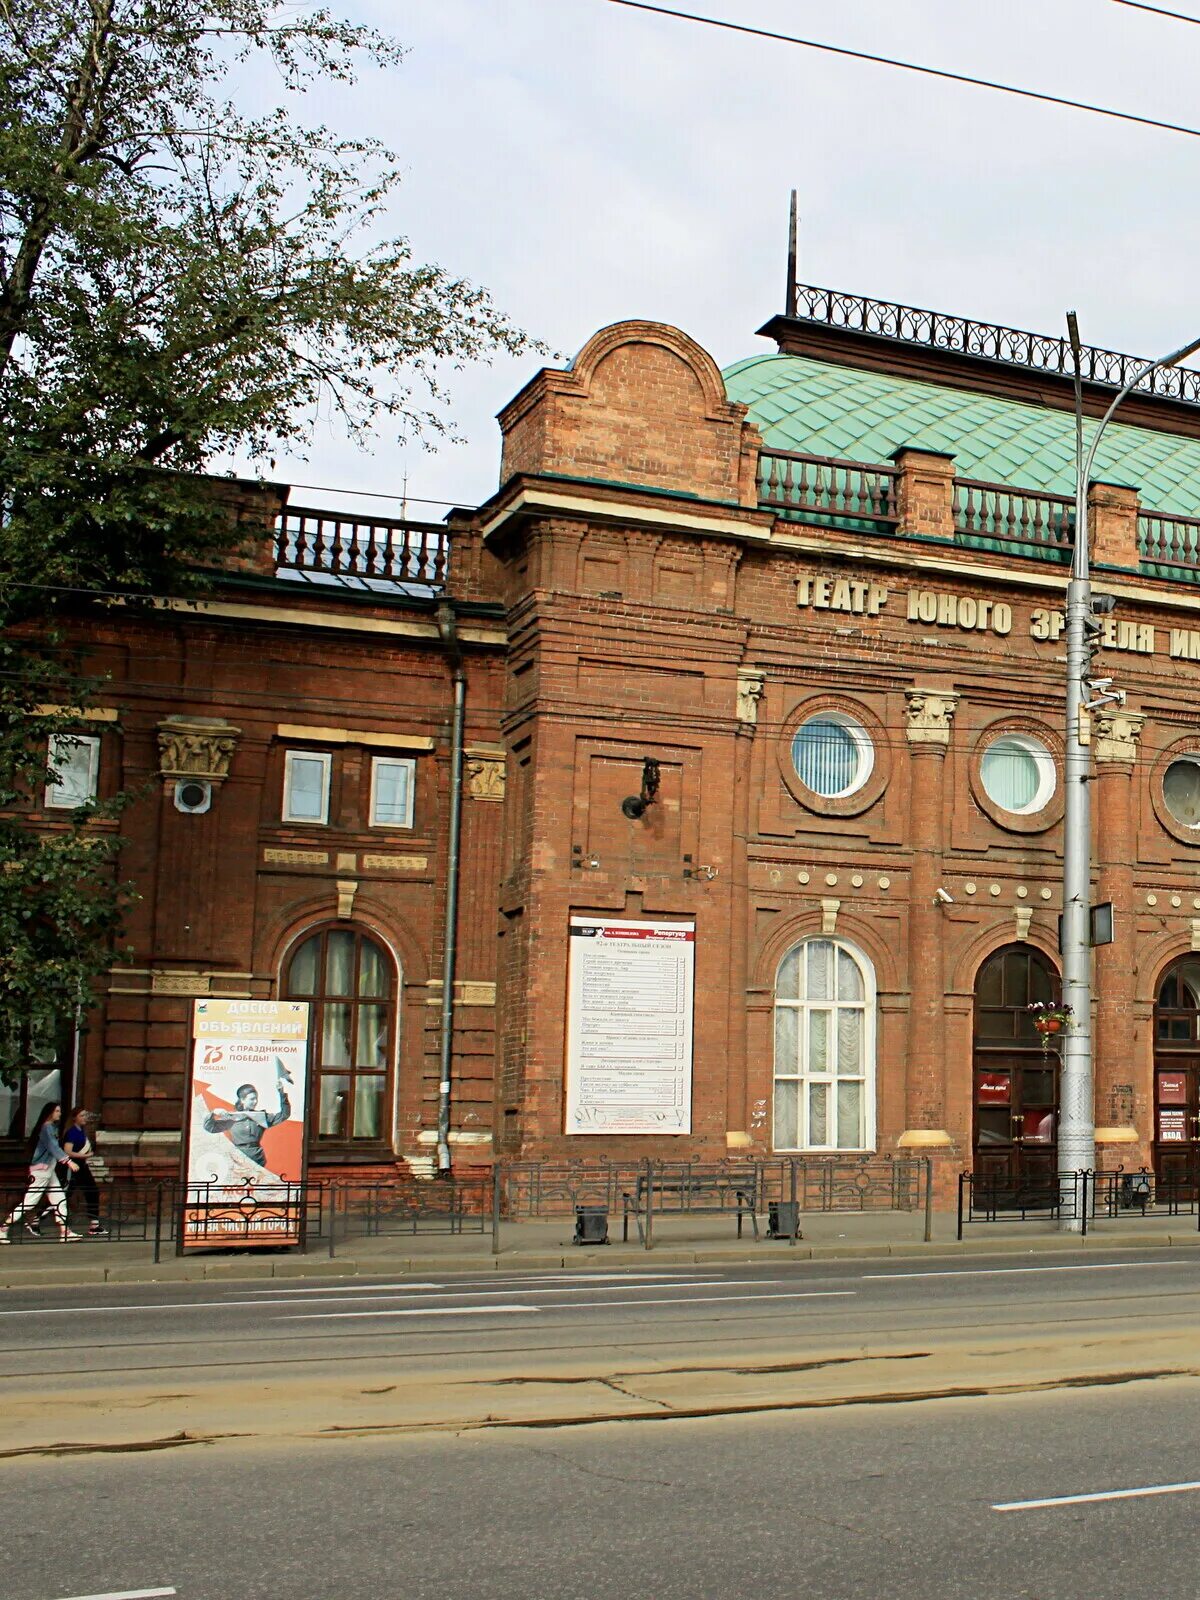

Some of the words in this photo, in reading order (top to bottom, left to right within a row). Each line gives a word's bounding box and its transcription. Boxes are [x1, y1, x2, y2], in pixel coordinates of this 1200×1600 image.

[797, 575, 888, 616] ТЕАТР
[907, 589, 1012, 635] ЮНОГО
[1030, 607, 1155, 653] ЗРЕЛЯ
[227, 1002, 278, 1014] ДОСКА
[200, 1021, 303, 1034] ОБЪЯВЛЕНИЙ
[237, 1045, 298, 1054] ПРАЗДНИКОМ
[229, 1055, 269, 1063] ПОБЕДЫ!
